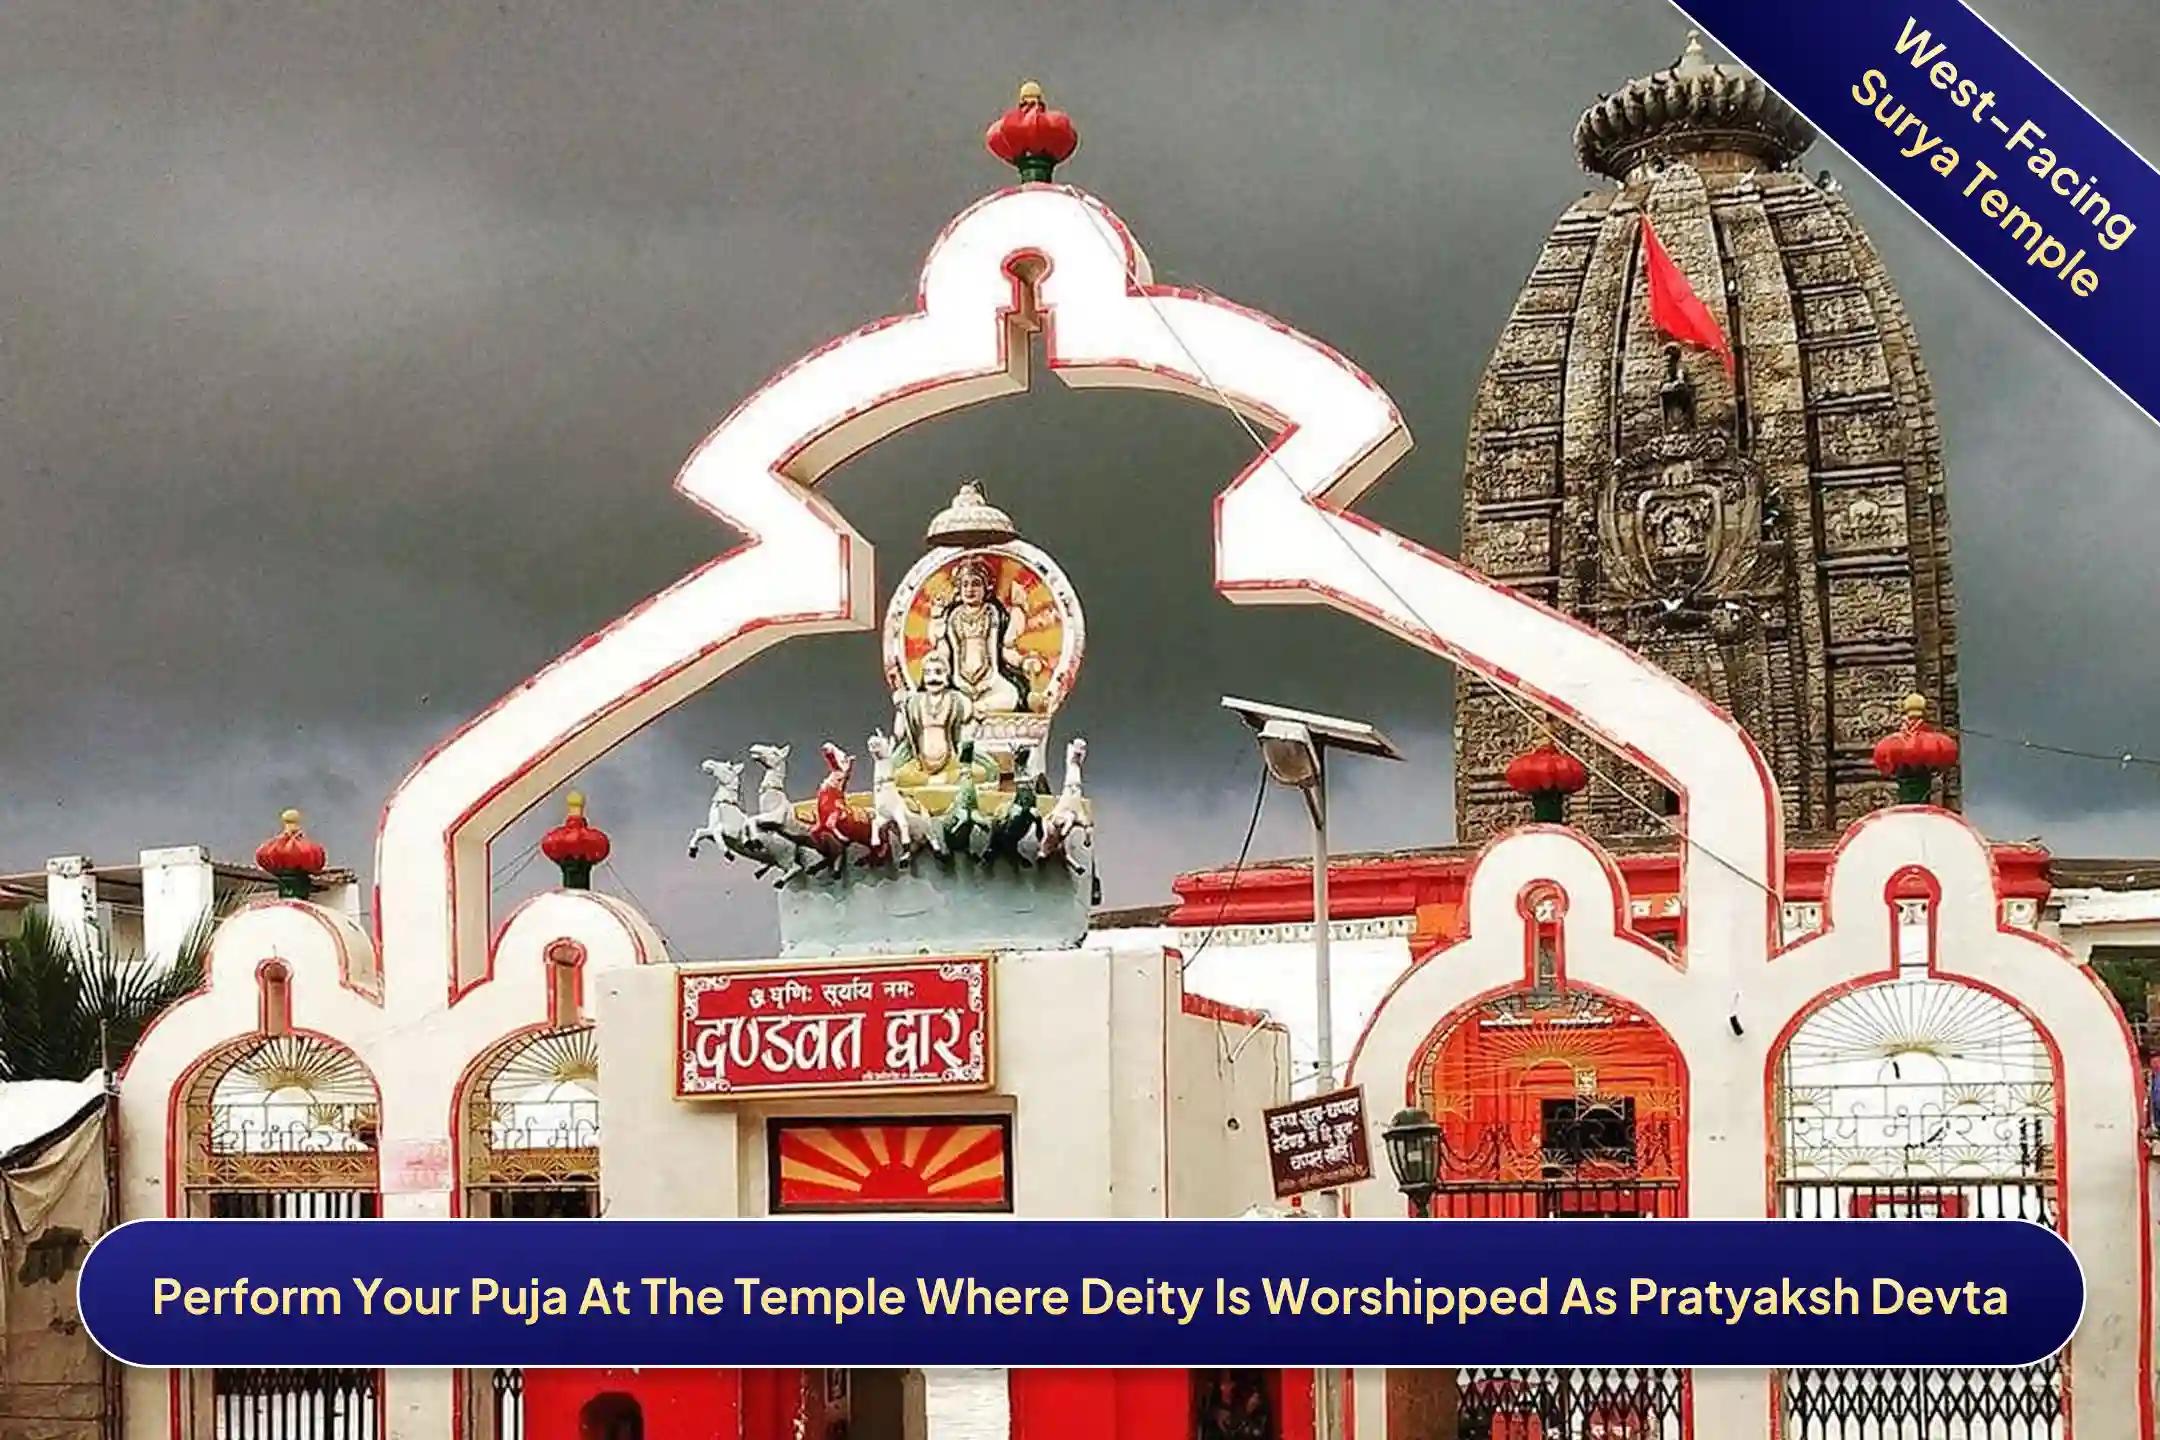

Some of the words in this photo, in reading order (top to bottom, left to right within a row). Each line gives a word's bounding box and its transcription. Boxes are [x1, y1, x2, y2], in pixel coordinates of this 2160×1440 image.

[820, 976, 874, 1006] सूर्याय
[881, 981, 915, 998] नमः
[695, 1013, 866, 1078] दण्डवत
[884, 1008, 964, 1073] द्वार
